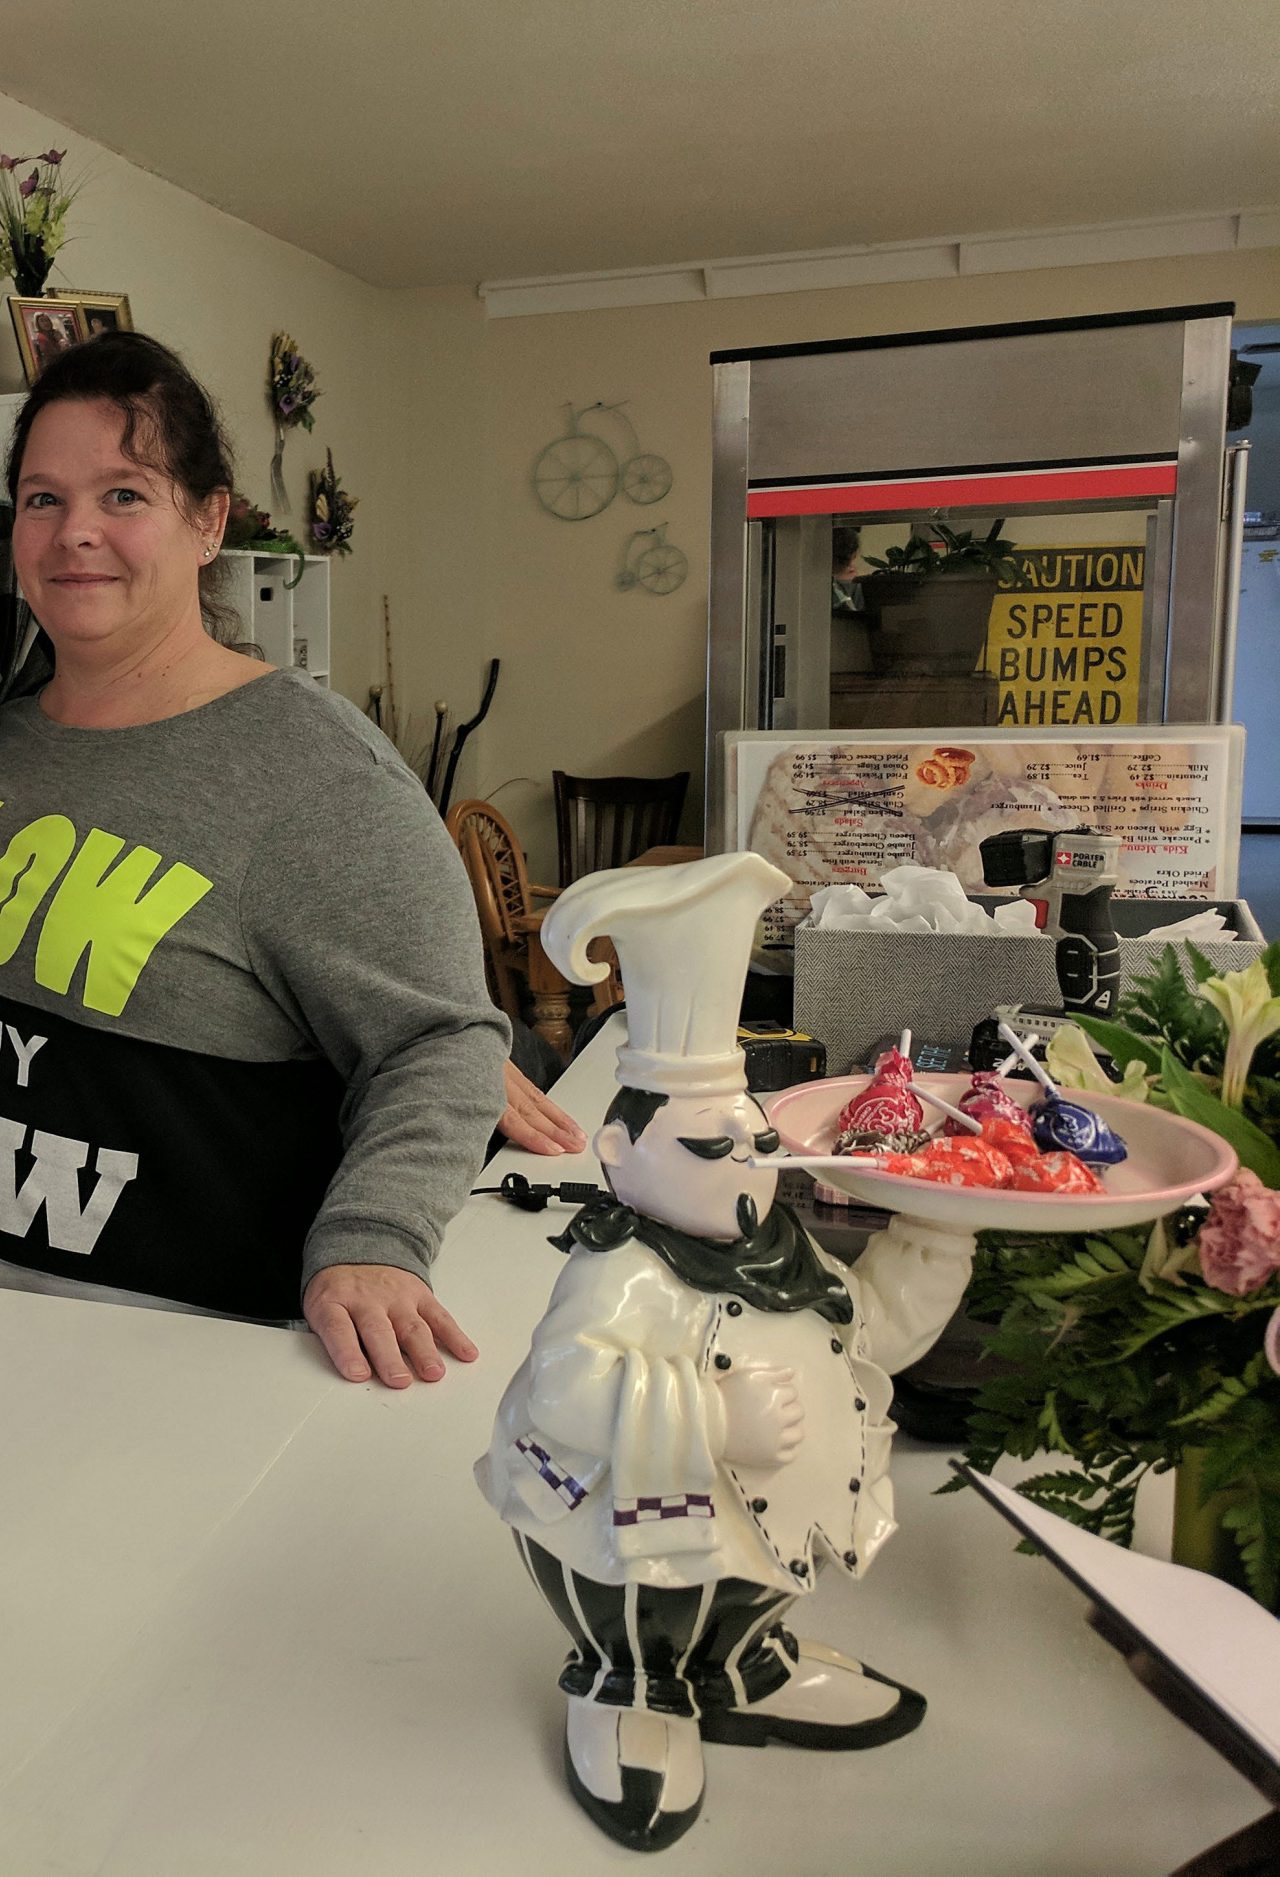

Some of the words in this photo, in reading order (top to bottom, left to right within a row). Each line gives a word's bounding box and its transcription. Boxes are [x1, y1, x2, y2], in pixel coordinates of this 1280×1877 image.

[1007, 602, 1123, 639] SPEED
[999, 646, 1127, 682] BUMPS
[998, 690, 1121, 725] AHEAD
[1076, 754, 1100, 762] $1.69
[1133, 754, 1161, 762] Coffee
[857, 762, 880, 771] Rings
[883, 763, 908, 771] Onion
[1026, 763, 1051, 771] $2.29
[1064, 763, 1087, 771] Juice
[886, 772, 908, 780] Fried
[1026, 773, 1050, 781] $1.89
[1072, 773, 1088, 781] Tea
[1167, 774, 1208, 782] Fountain
[1135, 781, 1168, 790] Drinks
[990, 803, 1041, 812] Hamburger
[1093, 805, 1126, 813] Grilled
[1140, 804, 1167, 813] Strips
[834, 818, 863, 827] Salads
[1128, 825, 1156, 833] Bacon
[1159, 825, 1180, 833] with
[1183, 824, 1202, 834] Egg
[1137, 835, 1157, 844] with
[1162, 835, 1202, 844] Pancake
[887, 842, 915, 850] Jumbo
[1163, 845, 1189, 855] Kids
[837, 850, 884, 858] Hamburger
[887, 851, 915, 859] Jumbo
[1073, 852, 1104, 861] PORTER
[1156, 870, 1181, 878] Okra
[1184, 870, 1209, 879] Fried
[1129, 879, 1169, 888] Potatoes
[1172, 880, 1209, 889] Mashed
